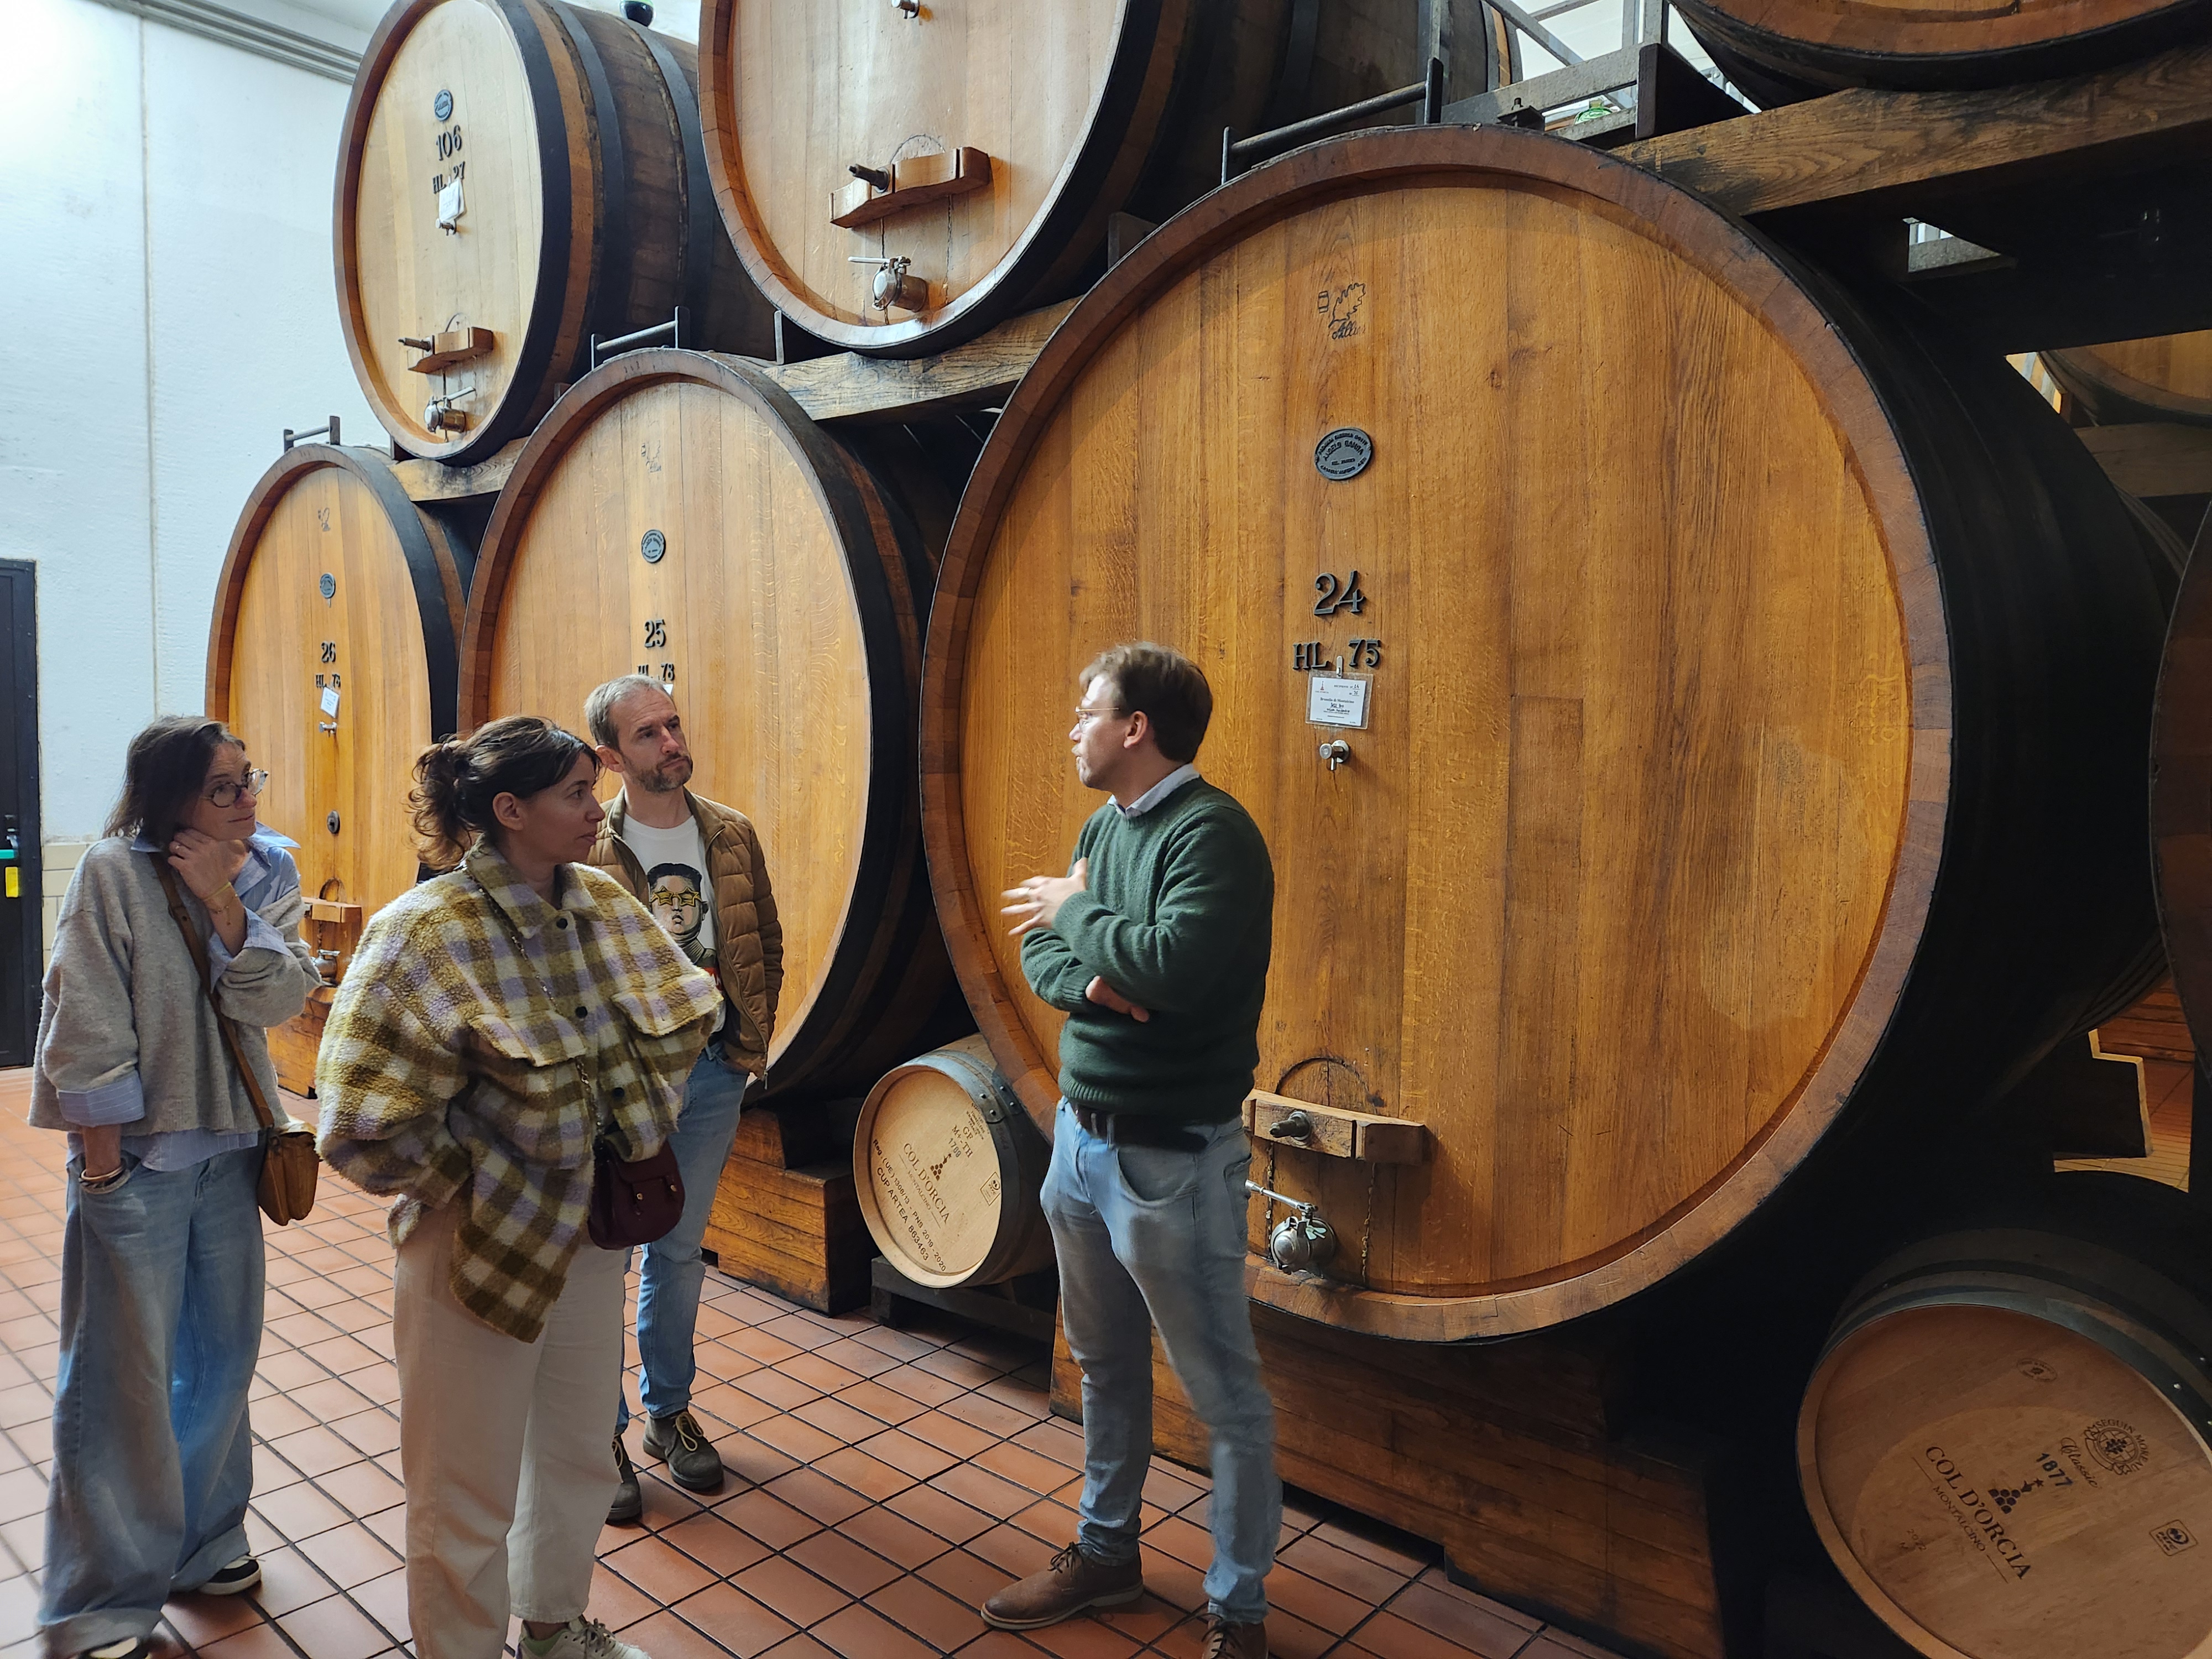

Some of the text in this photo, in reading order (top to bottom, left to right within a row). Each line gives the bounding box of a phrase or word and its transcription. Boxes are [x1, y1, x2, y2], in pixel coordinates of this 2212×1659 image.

[435, 124, 462, 161] 106
[1314, 570, 1365, 615] 24
[321, 641, 336, 663] 26
[644, 619, 666, 648] 25
[1293, 639, 1381, 670] HL 75
[877, 1167, 890, 1187] CUP
[888, 1189, 908, 1224] ARTEA
[904, 1143, 950, 1224] COL D'ORCIA
[907, 1170, 931, 1210] MONTALCINO
[2095, 1419, 2149, 1472] SEGUIN MOREAU
[2036, 1453, 2074, 1487] 1877
[1926, 1446, 2032, 1580] COL D'ORCIA
[1933, 1486, 1986, 1551] MONTALCINO
